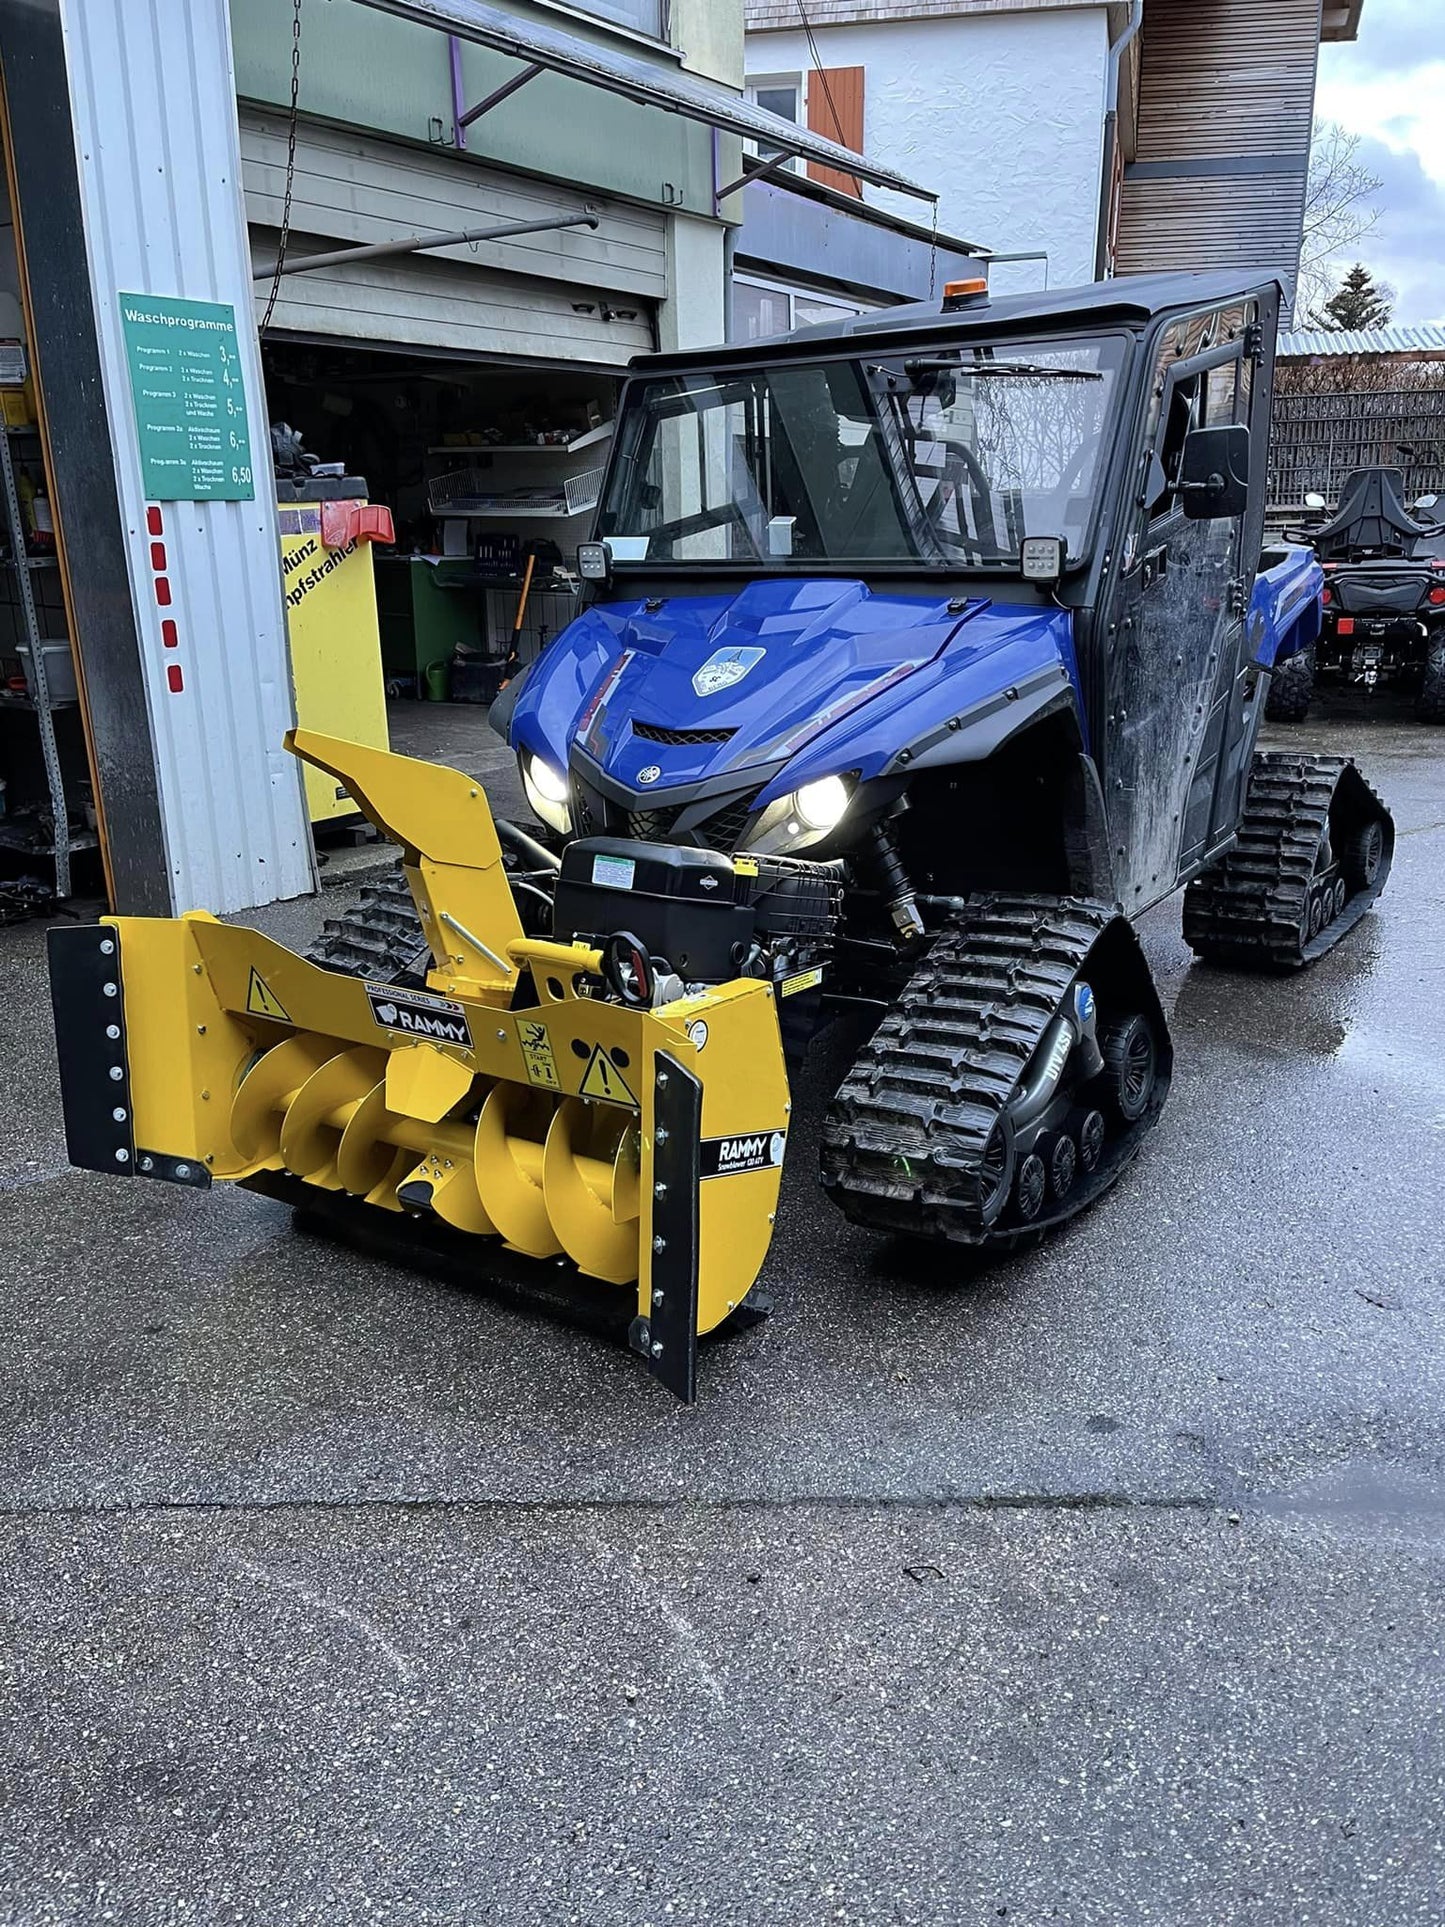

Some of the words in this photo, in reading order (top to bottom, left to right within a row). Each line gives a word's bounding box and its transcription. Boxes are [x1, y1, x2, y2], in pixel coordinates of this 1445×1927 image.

[125, 308, 234, 332] Waschprogramme
[136, 345, 166, 355] Programm
[187, 350, 211, 358] Waschen
[138, 363, 168, 372] Programm
[189, 367, 213, 375] Waschen
[190, 376, 215, 384] Trocknen
[142, 389, 172, 398] Programm
[193, 401, 218, 409] Trocknen
[146, 423, 176, 432] Programm
[231, 466, 251, 485] 6,50
[399, 1010, 467, 1042] RAMMY
[1044, 1052, 1064, 1081] UTV
[719, 1136, 768, 1162] RAMMY
